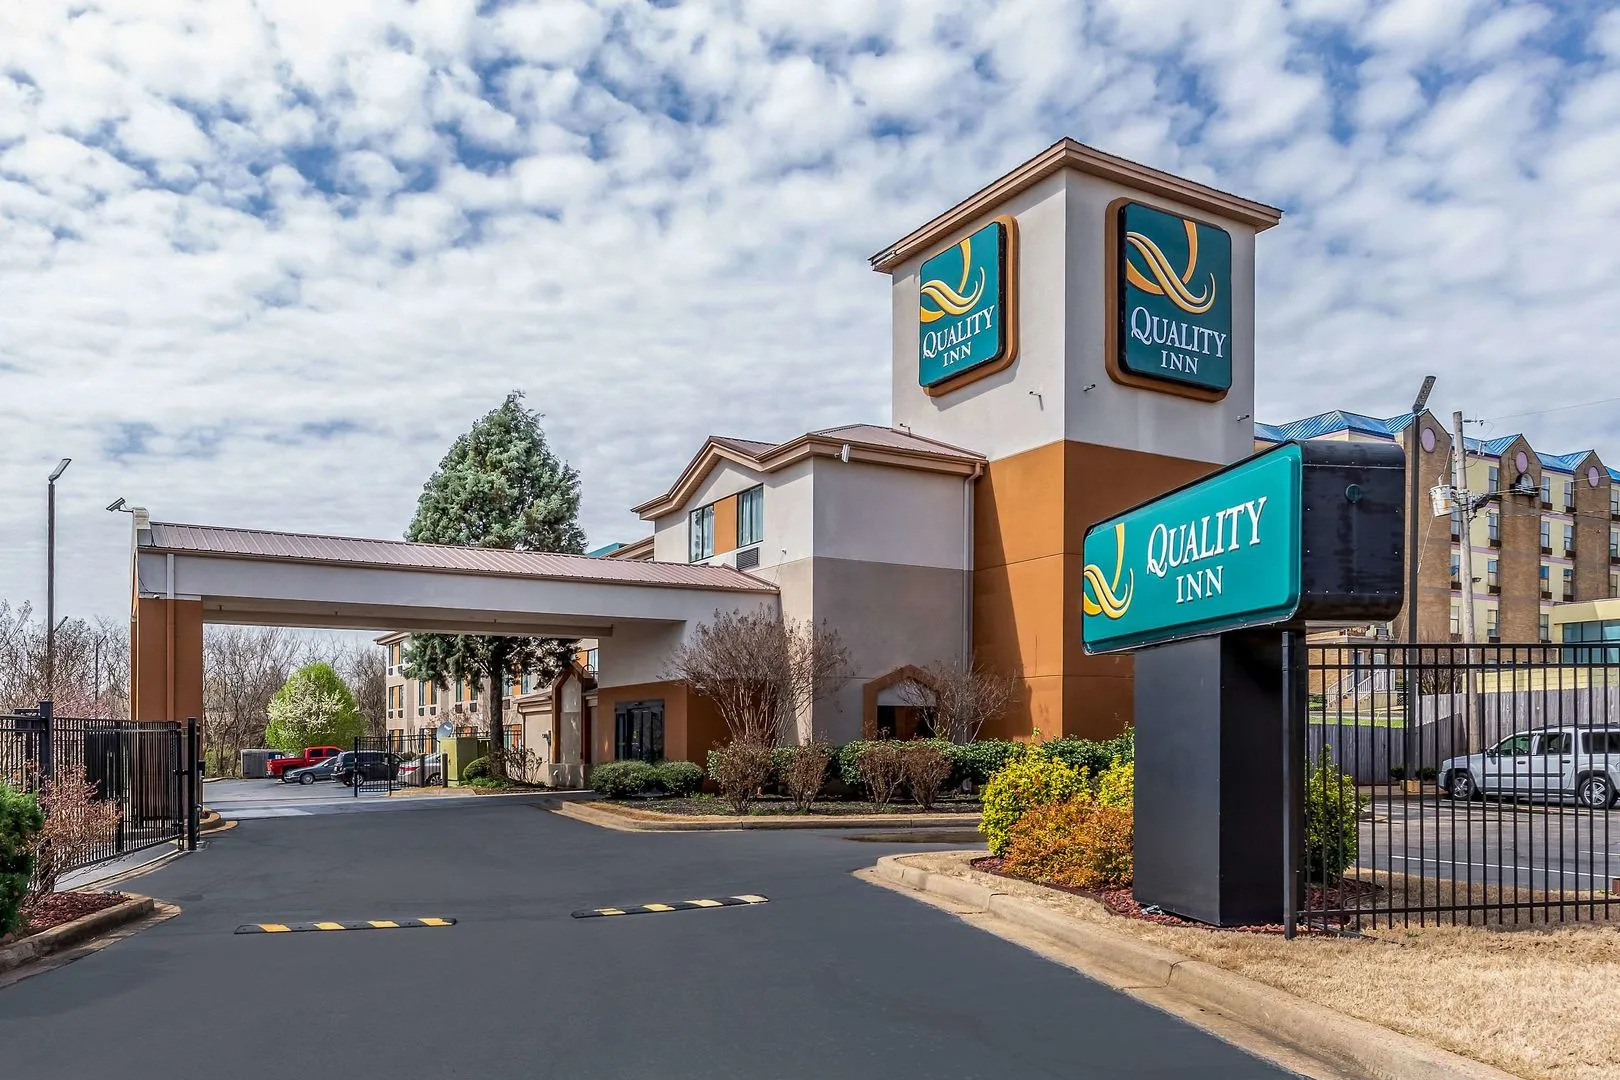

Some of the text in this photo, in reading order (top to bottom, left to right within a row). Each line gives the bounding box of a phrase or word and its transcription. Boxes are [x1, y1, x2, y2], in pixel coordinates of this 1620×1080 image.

[922, 305, 995, 359] QUALITY
[942, 342, 972, 367] INN
[1130, 306, 1227, 358] QUALITY
[1161, 350, 1199, 375] INN
[1146, 496, 1268, 578] QUALITY
[1176, 565, 1224, 604] INN
